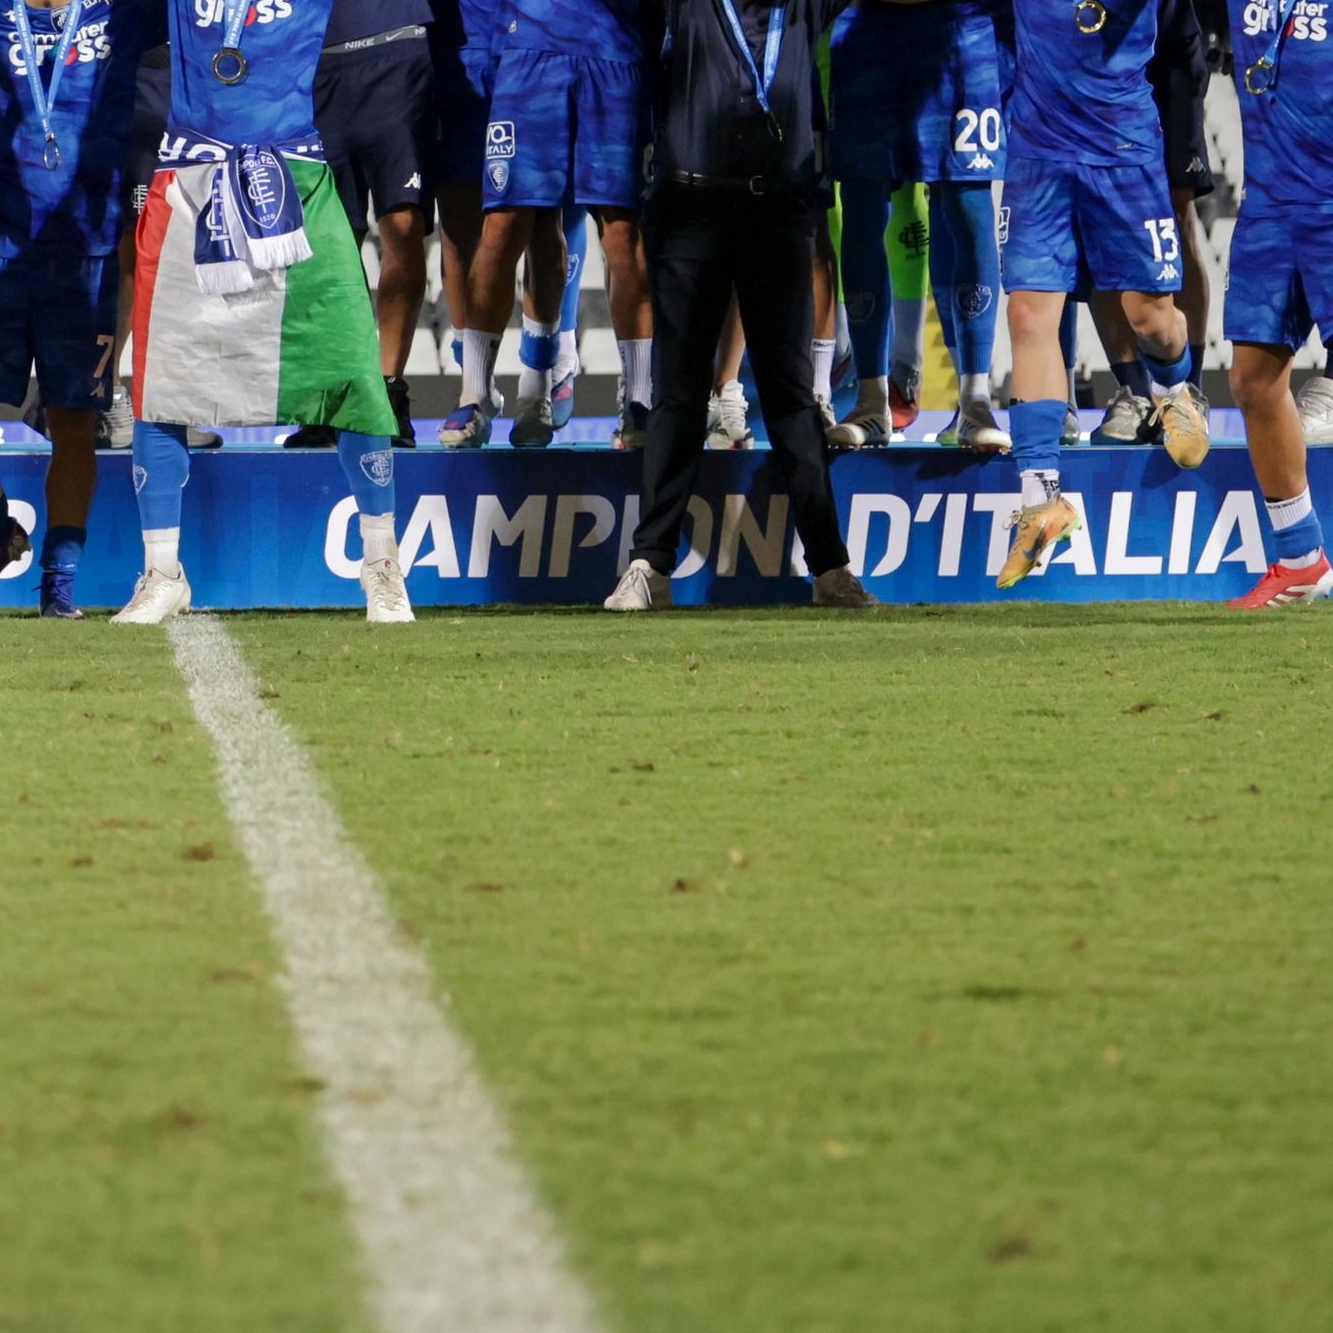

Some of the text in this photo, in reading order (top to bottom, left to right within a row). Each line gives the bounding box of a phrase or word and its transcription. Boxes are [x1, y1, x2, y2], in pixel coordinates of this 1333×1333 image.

[344, 37, 375, 50] NIKE
[1243, 3, 1328, 42] grss
[954, 108, 1000, 152] 20
[1144, 218, 1179, 262] 13
[93, 334, 114, 378] 7
